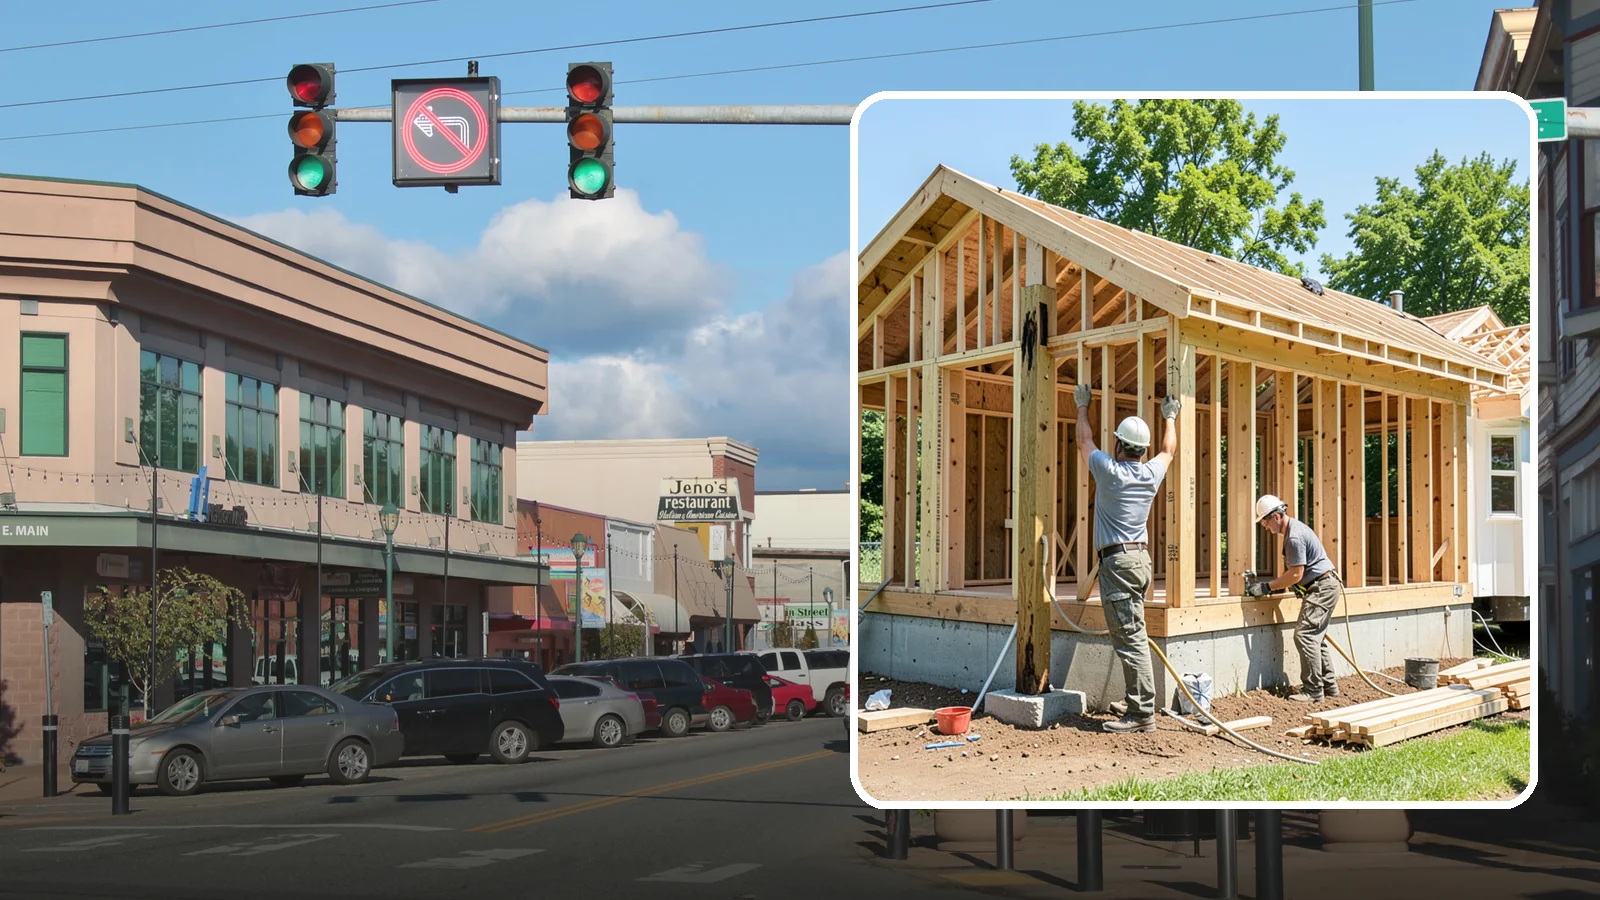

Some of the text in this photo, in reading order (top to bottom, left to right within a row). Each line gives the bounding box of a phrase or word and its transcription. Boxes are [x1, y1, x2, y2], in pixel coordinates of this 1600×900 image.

[670, 480, 727, 494] Jeno's
[665, 496, 730, 508] restaurant
[659, 510, 682, 519] Italian
[686, 510, 714, 518] American
[715, 510, 737, 518] Cuisine
[2, 525, 48, 536] E. MAIN
[798, 608, 828, 616] Street
